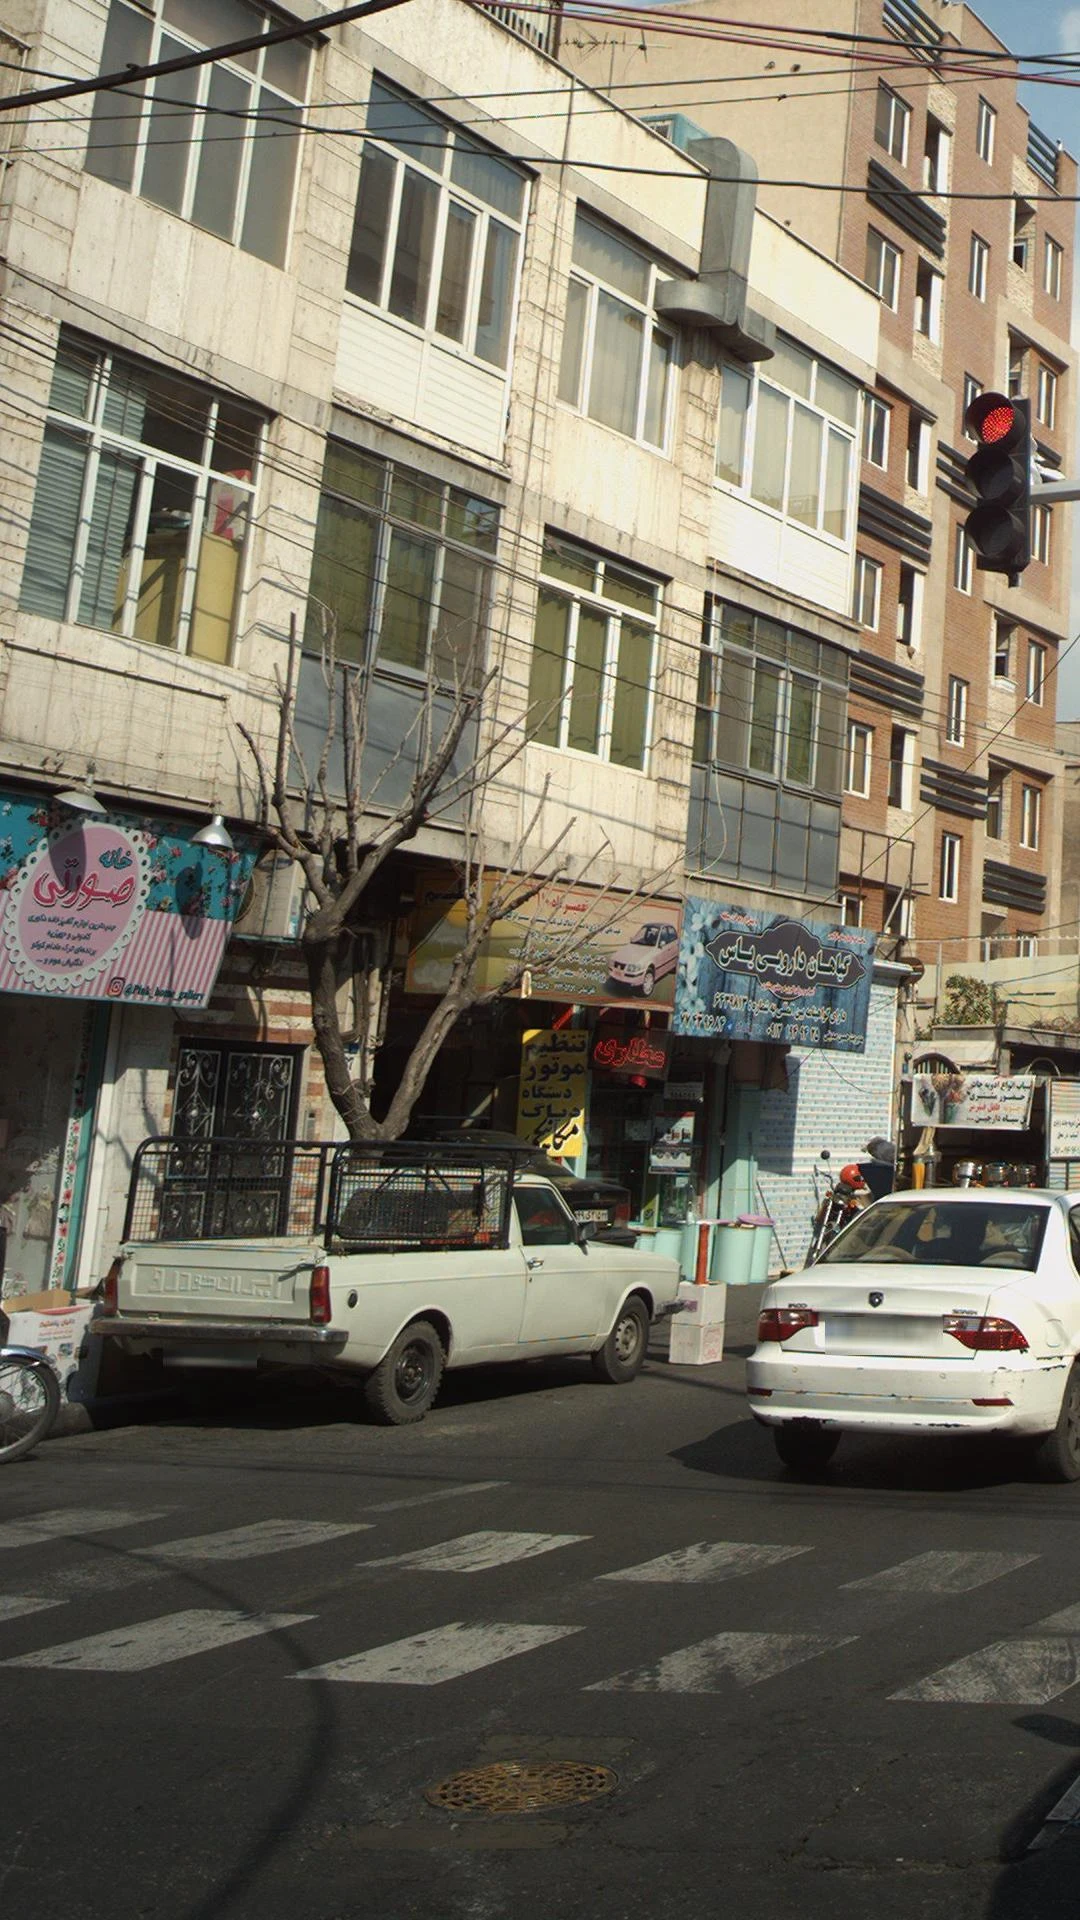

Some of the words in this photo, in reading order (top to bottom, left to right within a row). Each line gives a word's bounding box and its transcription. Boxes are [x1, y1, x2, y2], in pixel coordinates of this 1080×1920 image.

[98, 846, 133, 870] خانه
[33, 857, 136, 911] صورتی
[718, 935, 756, 970] یاس
[755, 945, 807, 977] دارویی
[806, 949, 852, 982] گیاهان
[525, 1033, 587, 1058] تنظیم
[593, 1037, 666, 1068] عطاری
[525, 1057, 585, 1082] موتور
[522, 1085, 573, 1099] دستگاه
[969, 1091, 998, 1102] مشتری
[999, 1093, 1025, 1103] حضور
[1002, 1114, 1019, 1125] سیاه
